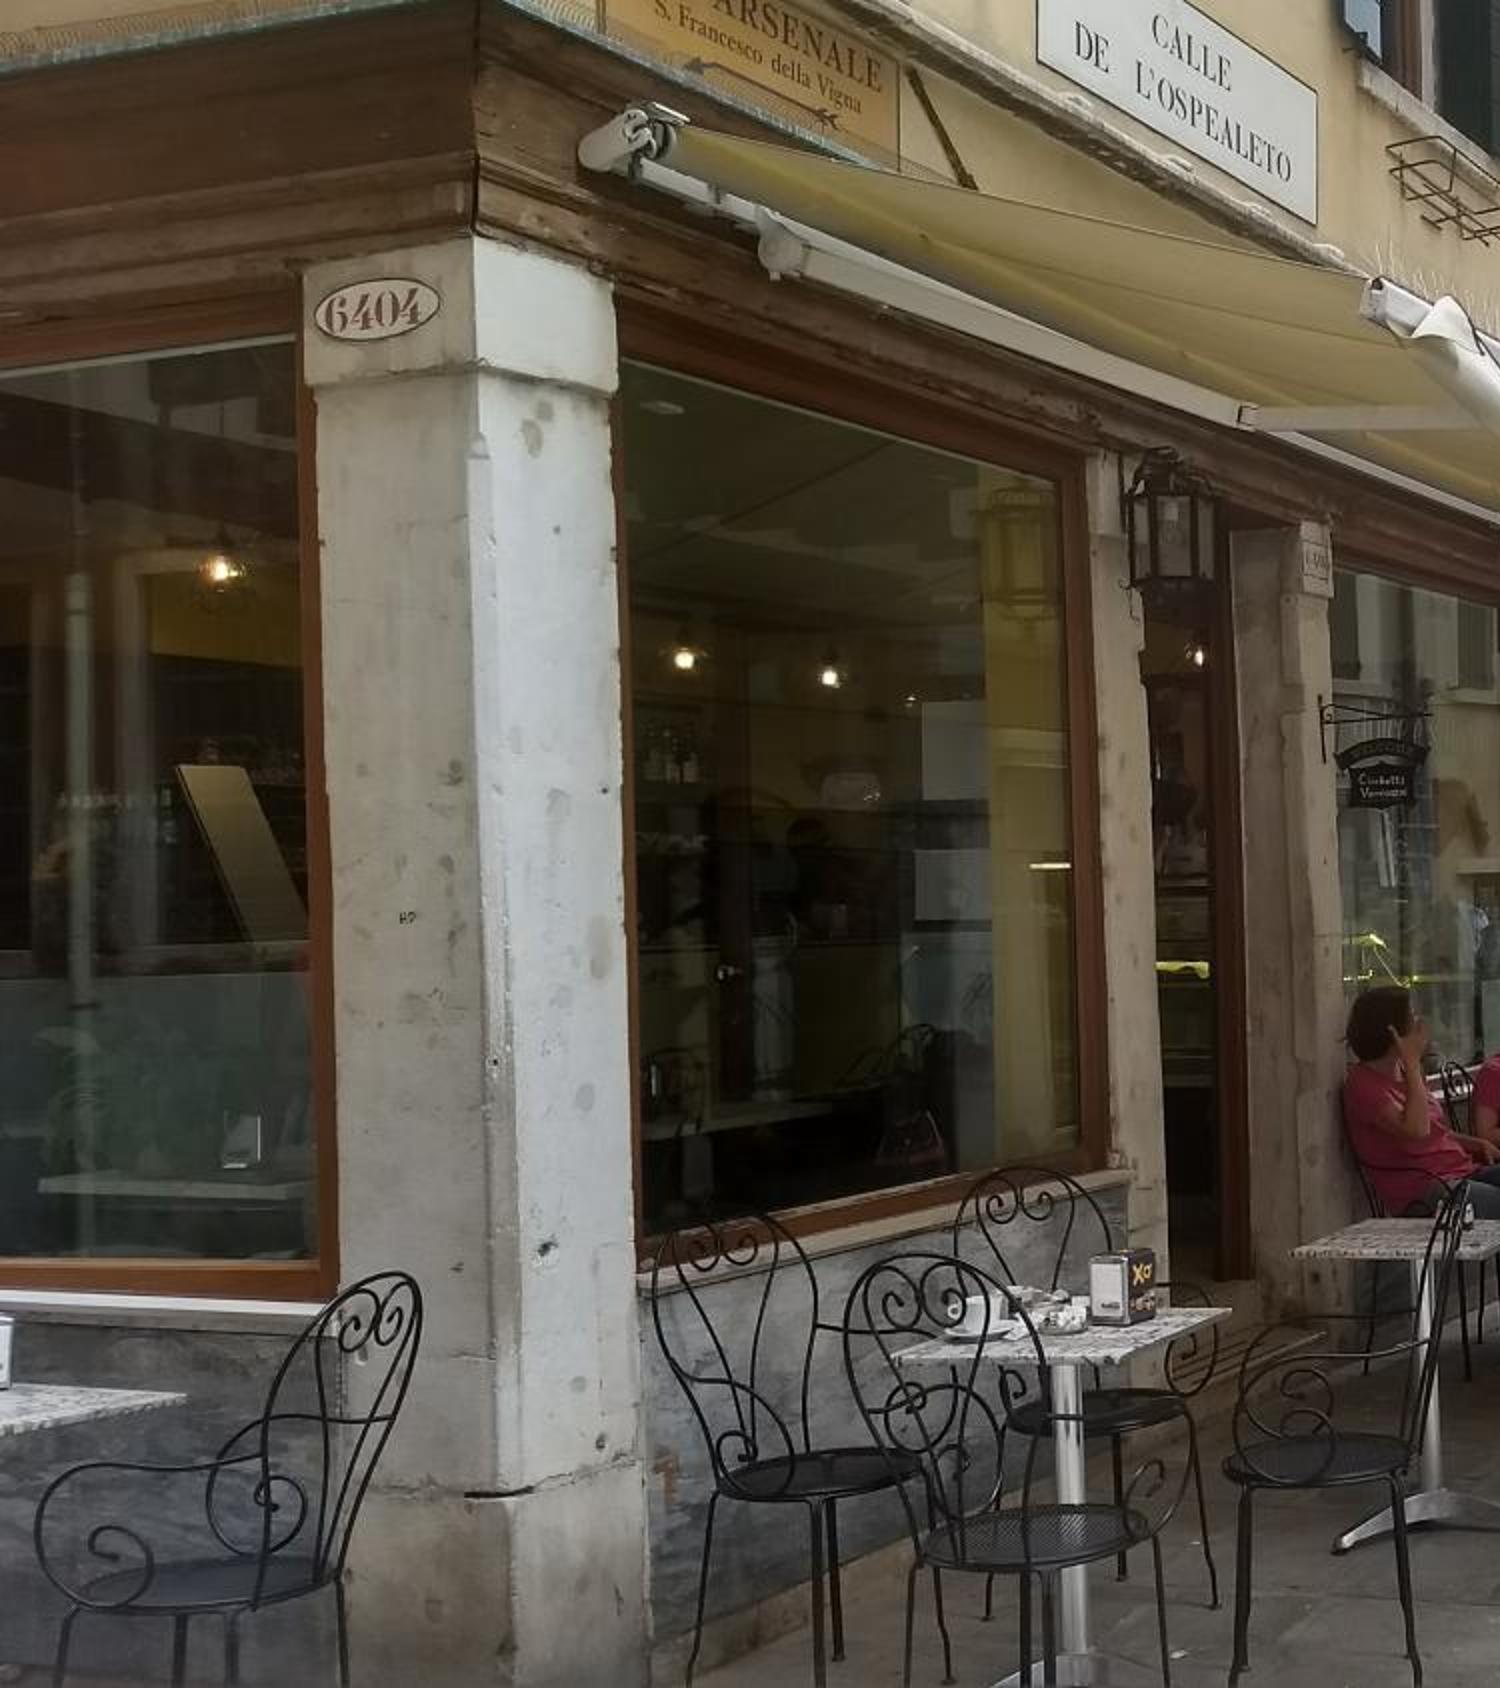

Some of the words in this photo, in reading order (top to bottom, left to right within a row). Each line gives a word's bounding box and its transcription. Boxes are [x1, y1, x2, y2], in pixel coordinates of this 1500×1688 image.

[679, 3, 763, 64] Francesco
[771, 54, 810, 88] della
[818, 73, 862, 114] Vigna
[1152, 14, 1232, 92] CALLE
[1075, 21, 1109, 73] DE
[1136, 59, 1291, 182] L'OSPEALETO
[325, 287, 419, 333] 6404
